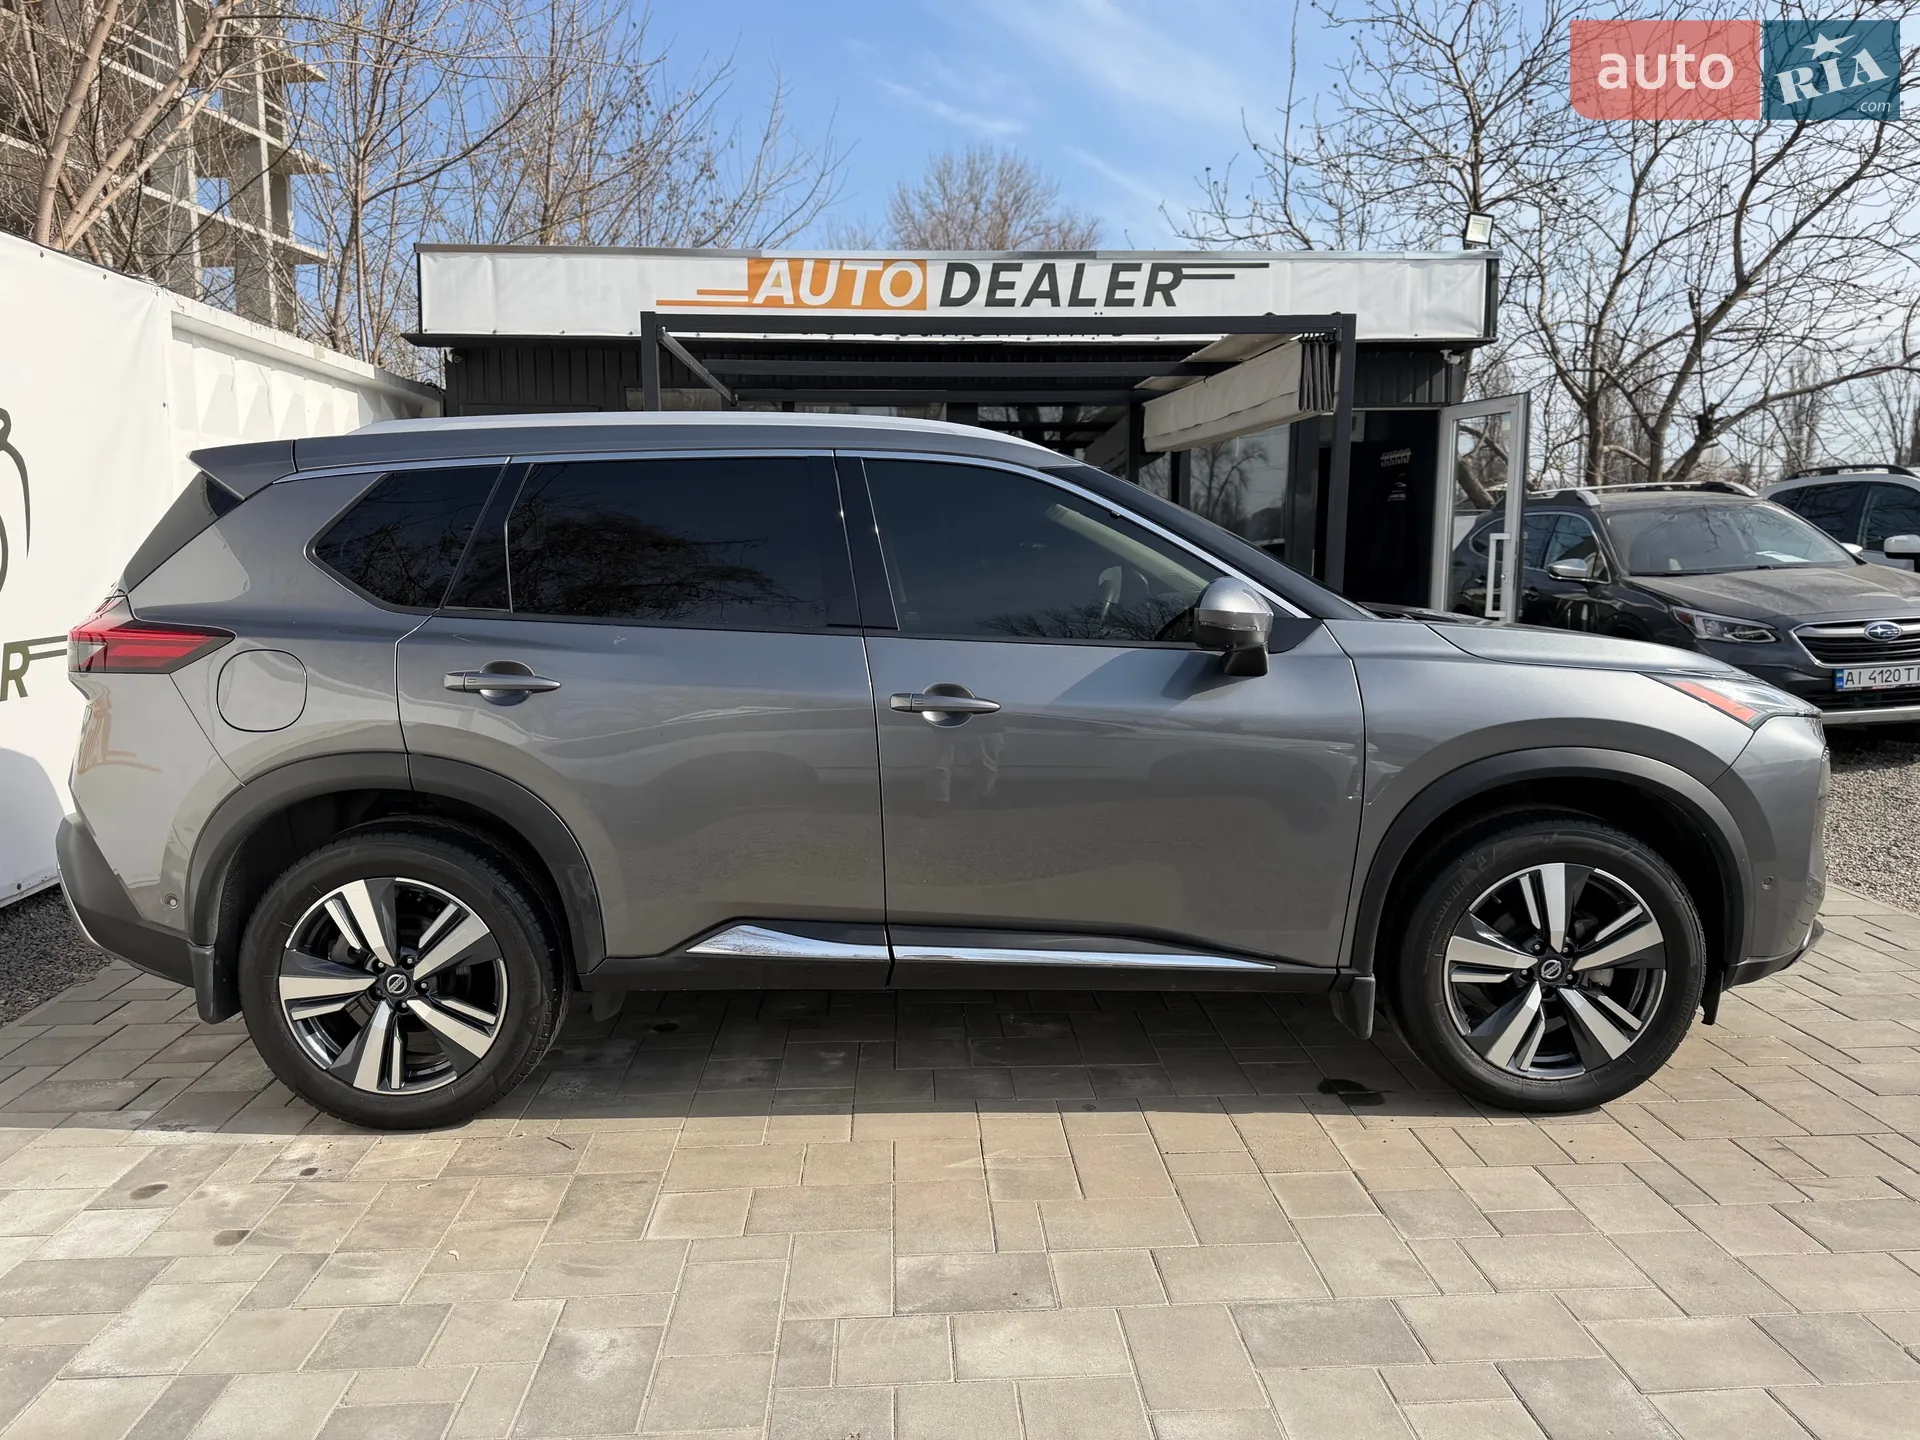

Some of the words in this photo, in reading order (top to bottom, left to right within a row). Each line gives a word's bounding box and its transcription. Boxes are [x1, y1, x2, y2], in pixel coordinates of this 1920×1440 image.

[752, 259, 924, 306] AUTO
[940, 262, 1183, 308] DEALER
[1845, 671, 1862, 686] AI
[1868, 669, 1901, 683] 4120
